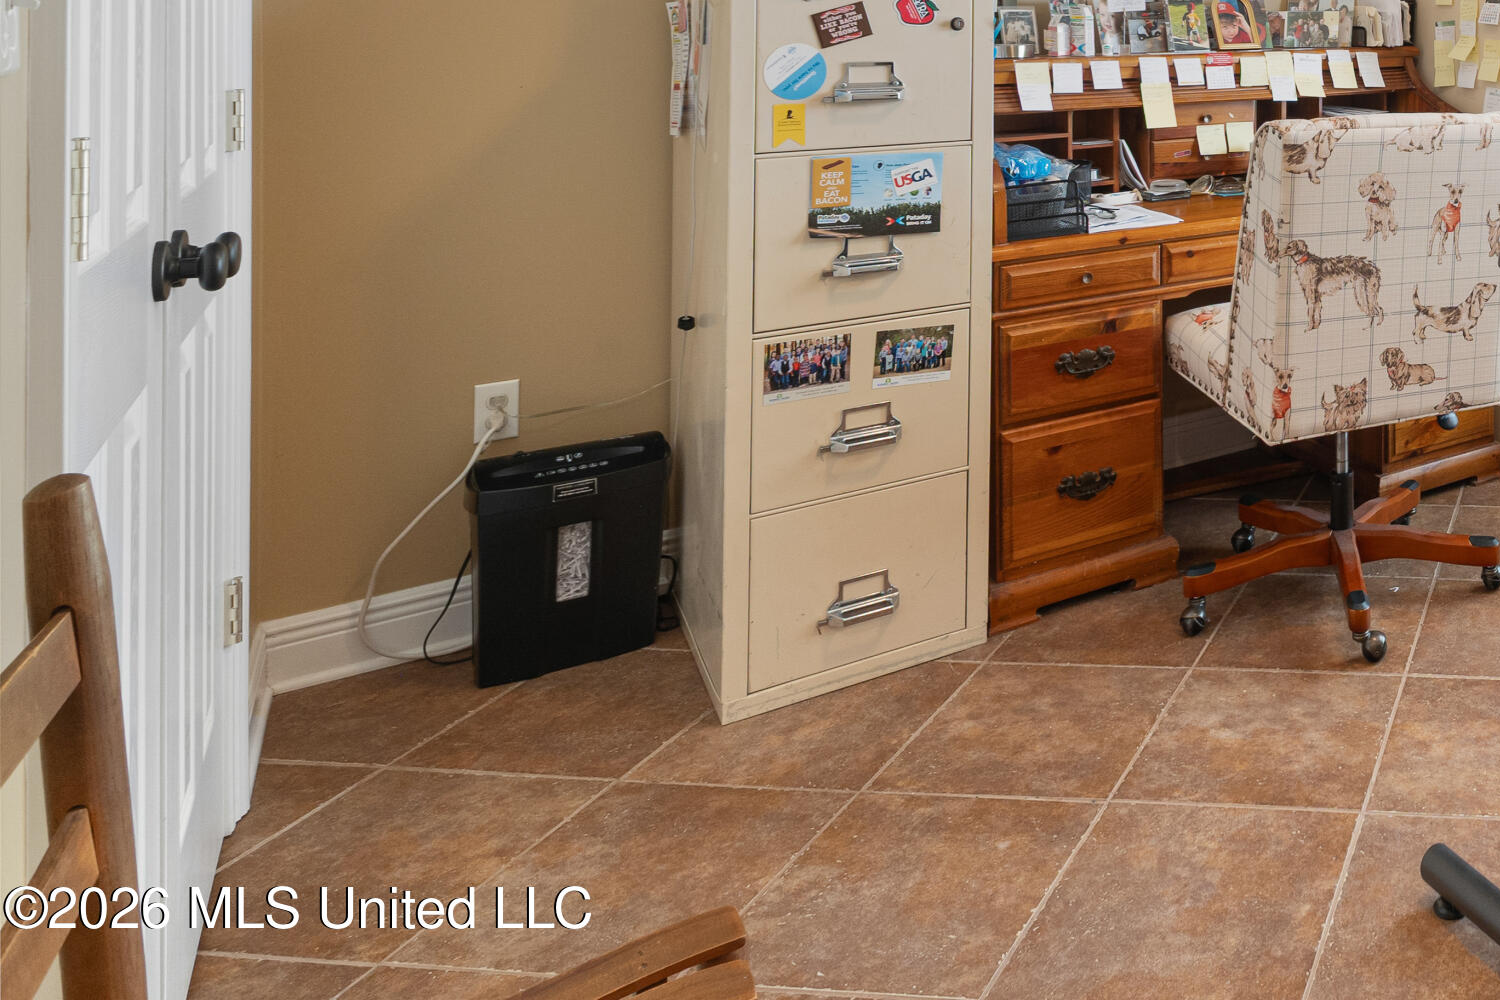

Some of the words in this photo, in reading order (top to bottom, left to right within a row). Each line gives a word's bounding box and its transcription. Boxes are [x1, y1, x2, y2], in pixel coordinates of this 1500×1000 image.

[820, 20, 839, 31] LIKE
[839, 13, 863, 26] BACON
[821, 171, 844, 180] KEEP
[893, 168, 933, 188] USGA
[819, 178, 845, 187] CALM
[823, 189, 841, 198] EAT
[815, 196, 848, 205] BACON
